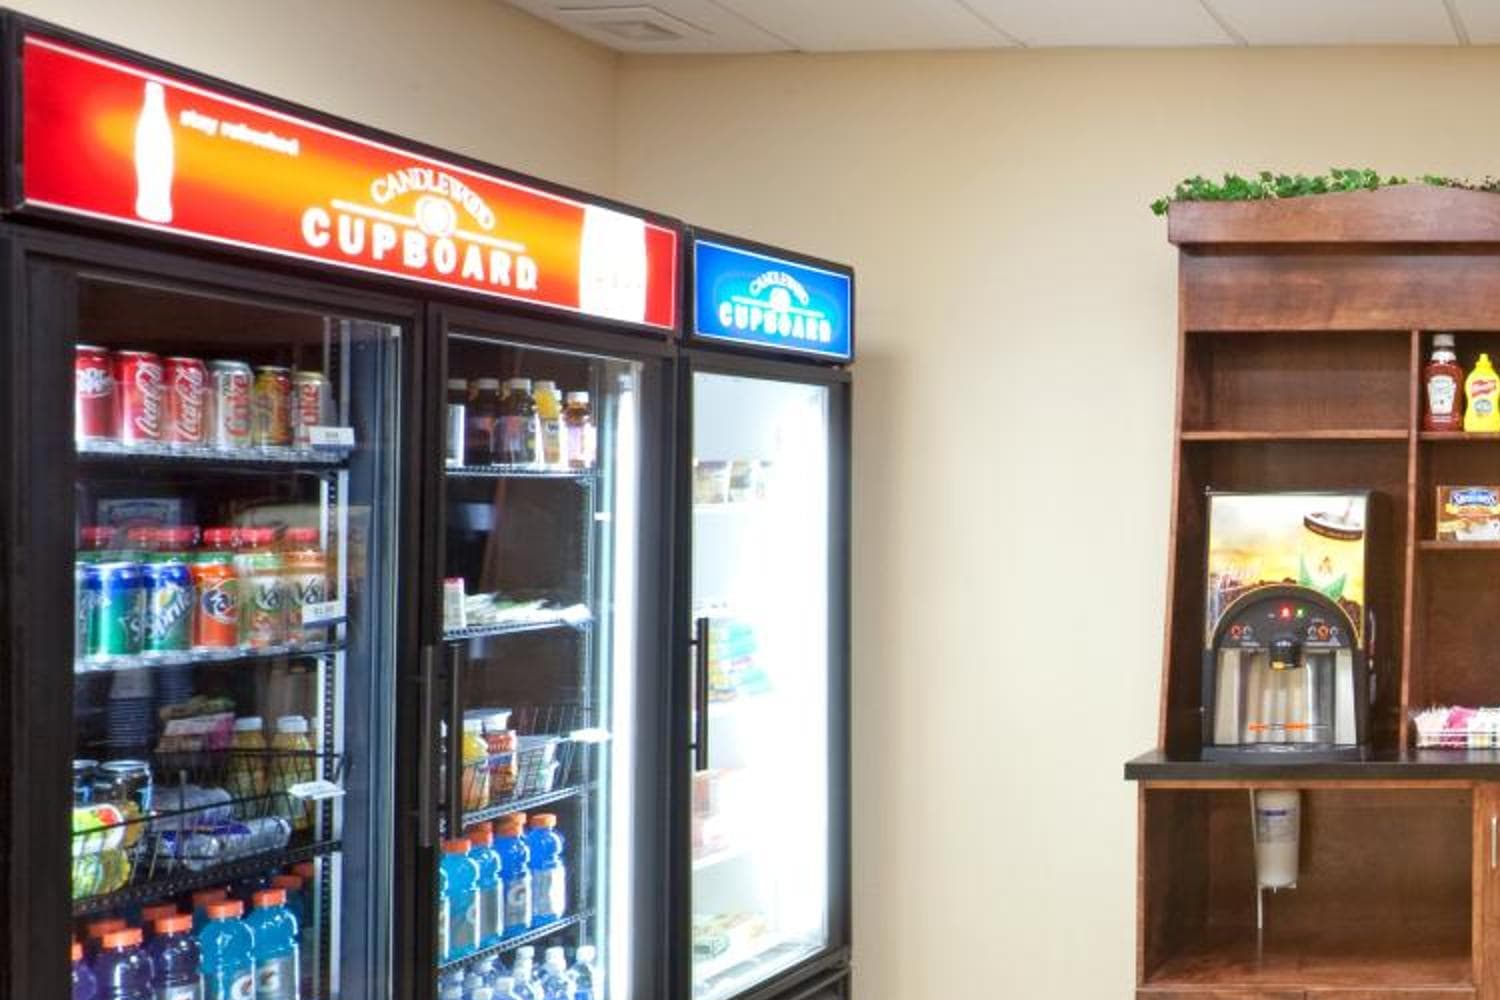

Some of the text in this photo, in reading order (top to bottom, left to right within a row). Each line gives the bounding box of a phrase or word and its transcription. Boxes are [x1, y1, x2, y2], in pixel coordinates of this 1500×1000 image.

[370, 167, 495, 230] CANDLEWOOD
[301, 207, 538, 290] CUPBOARD
[718, 301, 832, 344] CUPBOARD
